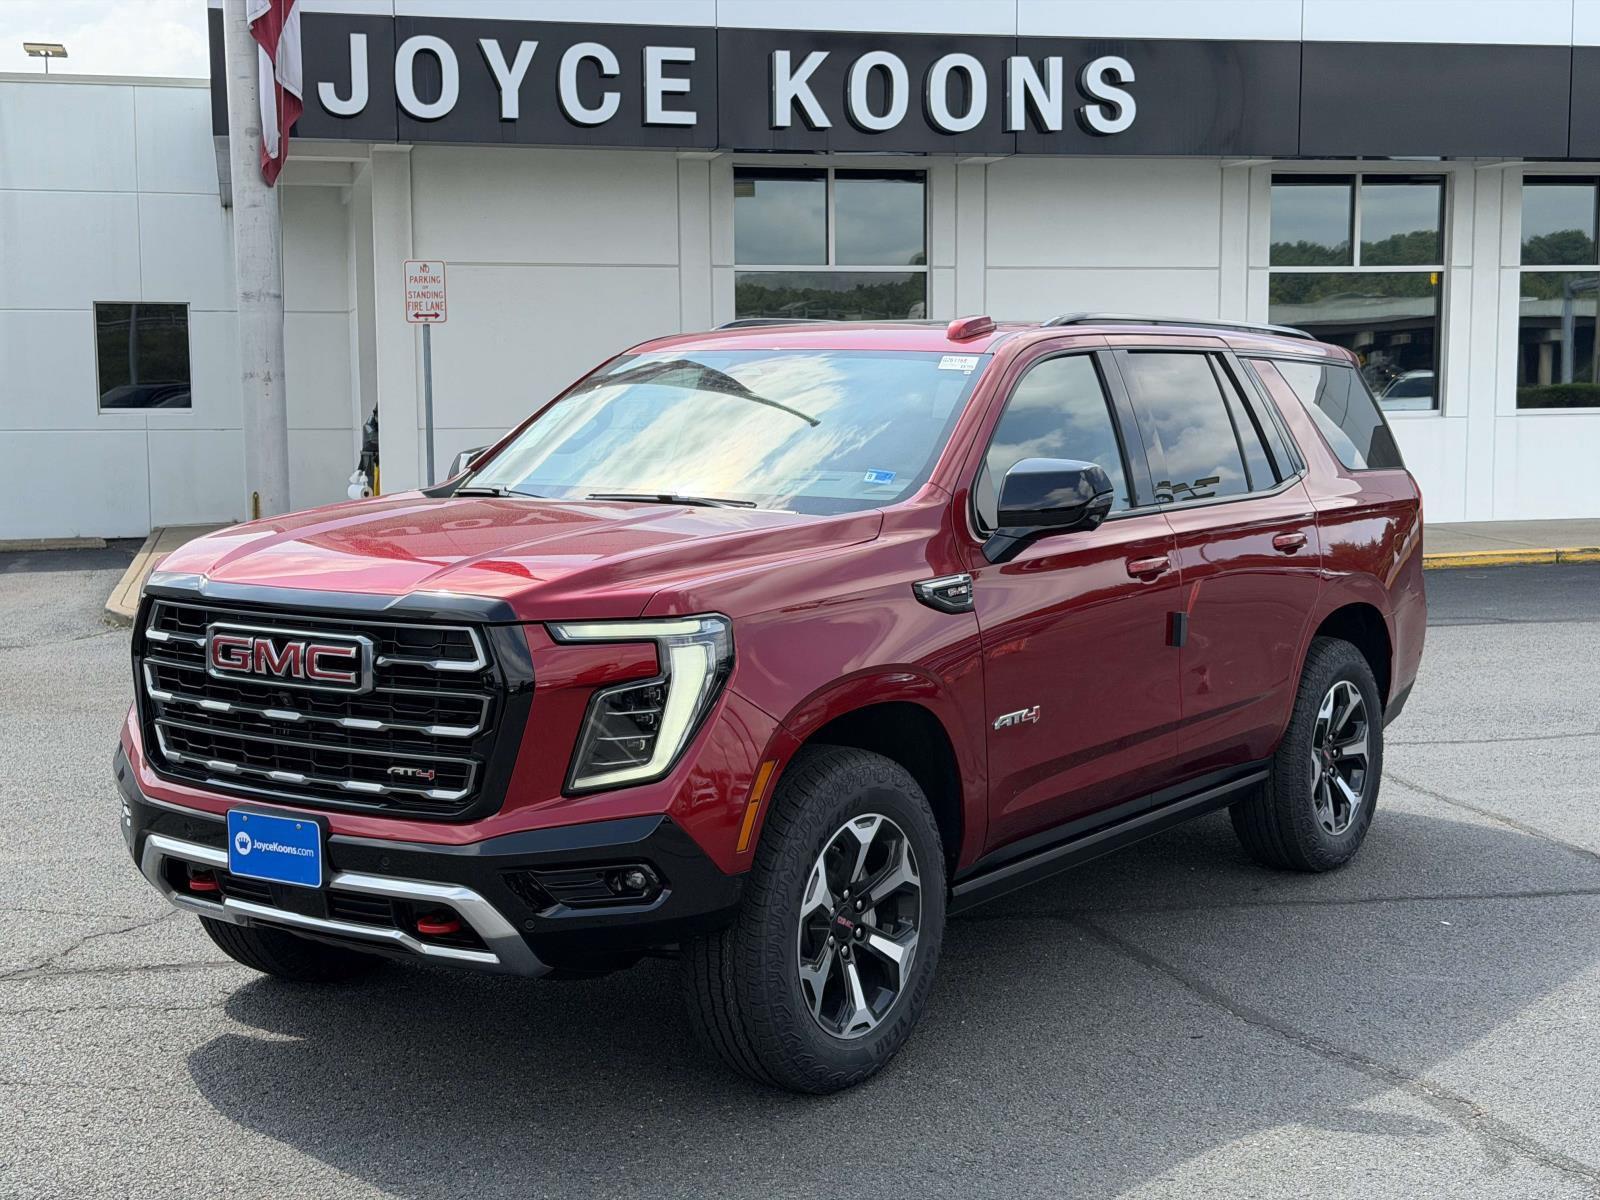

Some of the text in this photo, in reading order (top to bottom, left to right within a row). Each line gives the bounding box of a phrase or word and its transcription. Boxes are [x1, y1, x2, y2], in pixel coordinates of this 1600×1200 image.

[317, 33, 1137, 134] JOYCE KOONS
[419, 264, 430, 273] NO
[409, 275, 441, 284] PARKING
[407, 290, 444, 299] STANDING
[407, 301, 445, 311] FIRE LANE
[212, 634, 357, 684] GMC
[993, 704, 1041, 731] AT4
[386, 766, 435, 781] AT4
[252, 838, 315, 858] JoyceKoons.com
[837, 915, 855, 928] GMC
